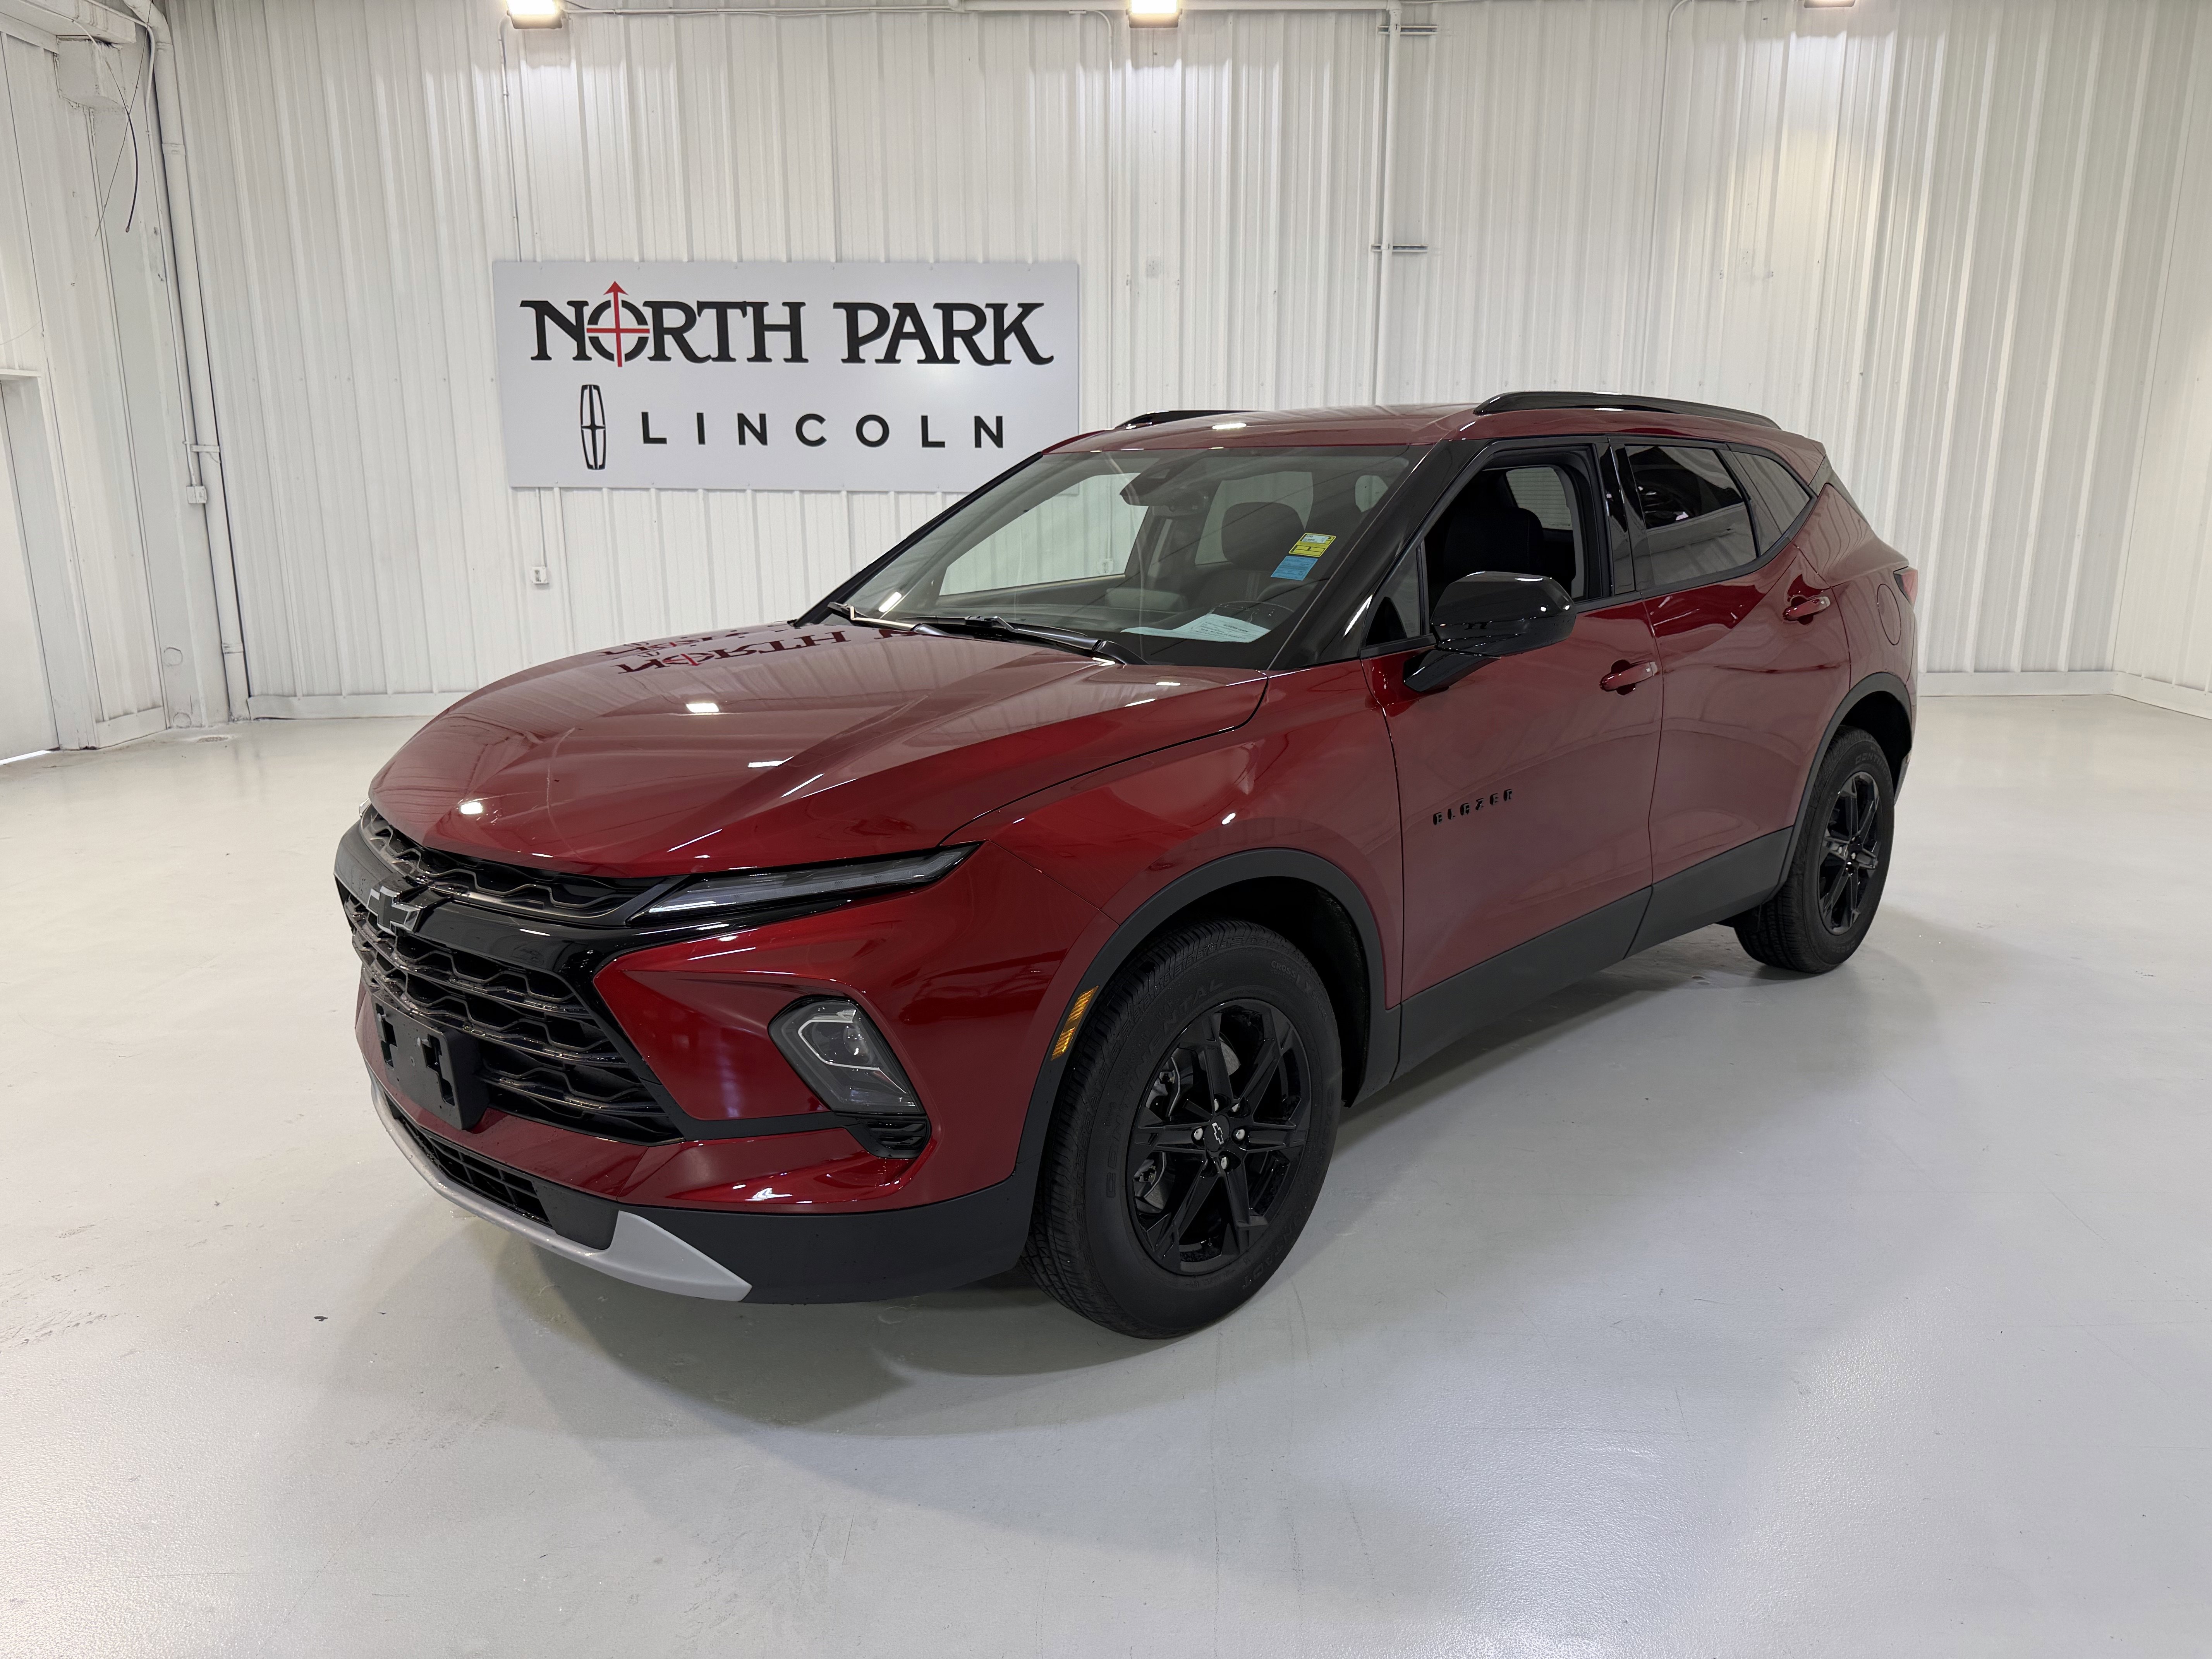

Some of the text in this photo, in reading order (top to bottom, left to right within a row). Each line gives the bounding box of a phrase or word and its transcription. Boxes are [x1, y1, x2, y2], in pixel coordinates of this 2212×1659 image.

[520, 300, 1054, 366] NORTH PARK
[641, 411, 1003, 448] LINCOLN
[1432, 788, 1513, 825] BLAZER
[1271, 960, 1297, 979] CROSS
[1106, 979, 1223, 1199] CONTINENTAL
